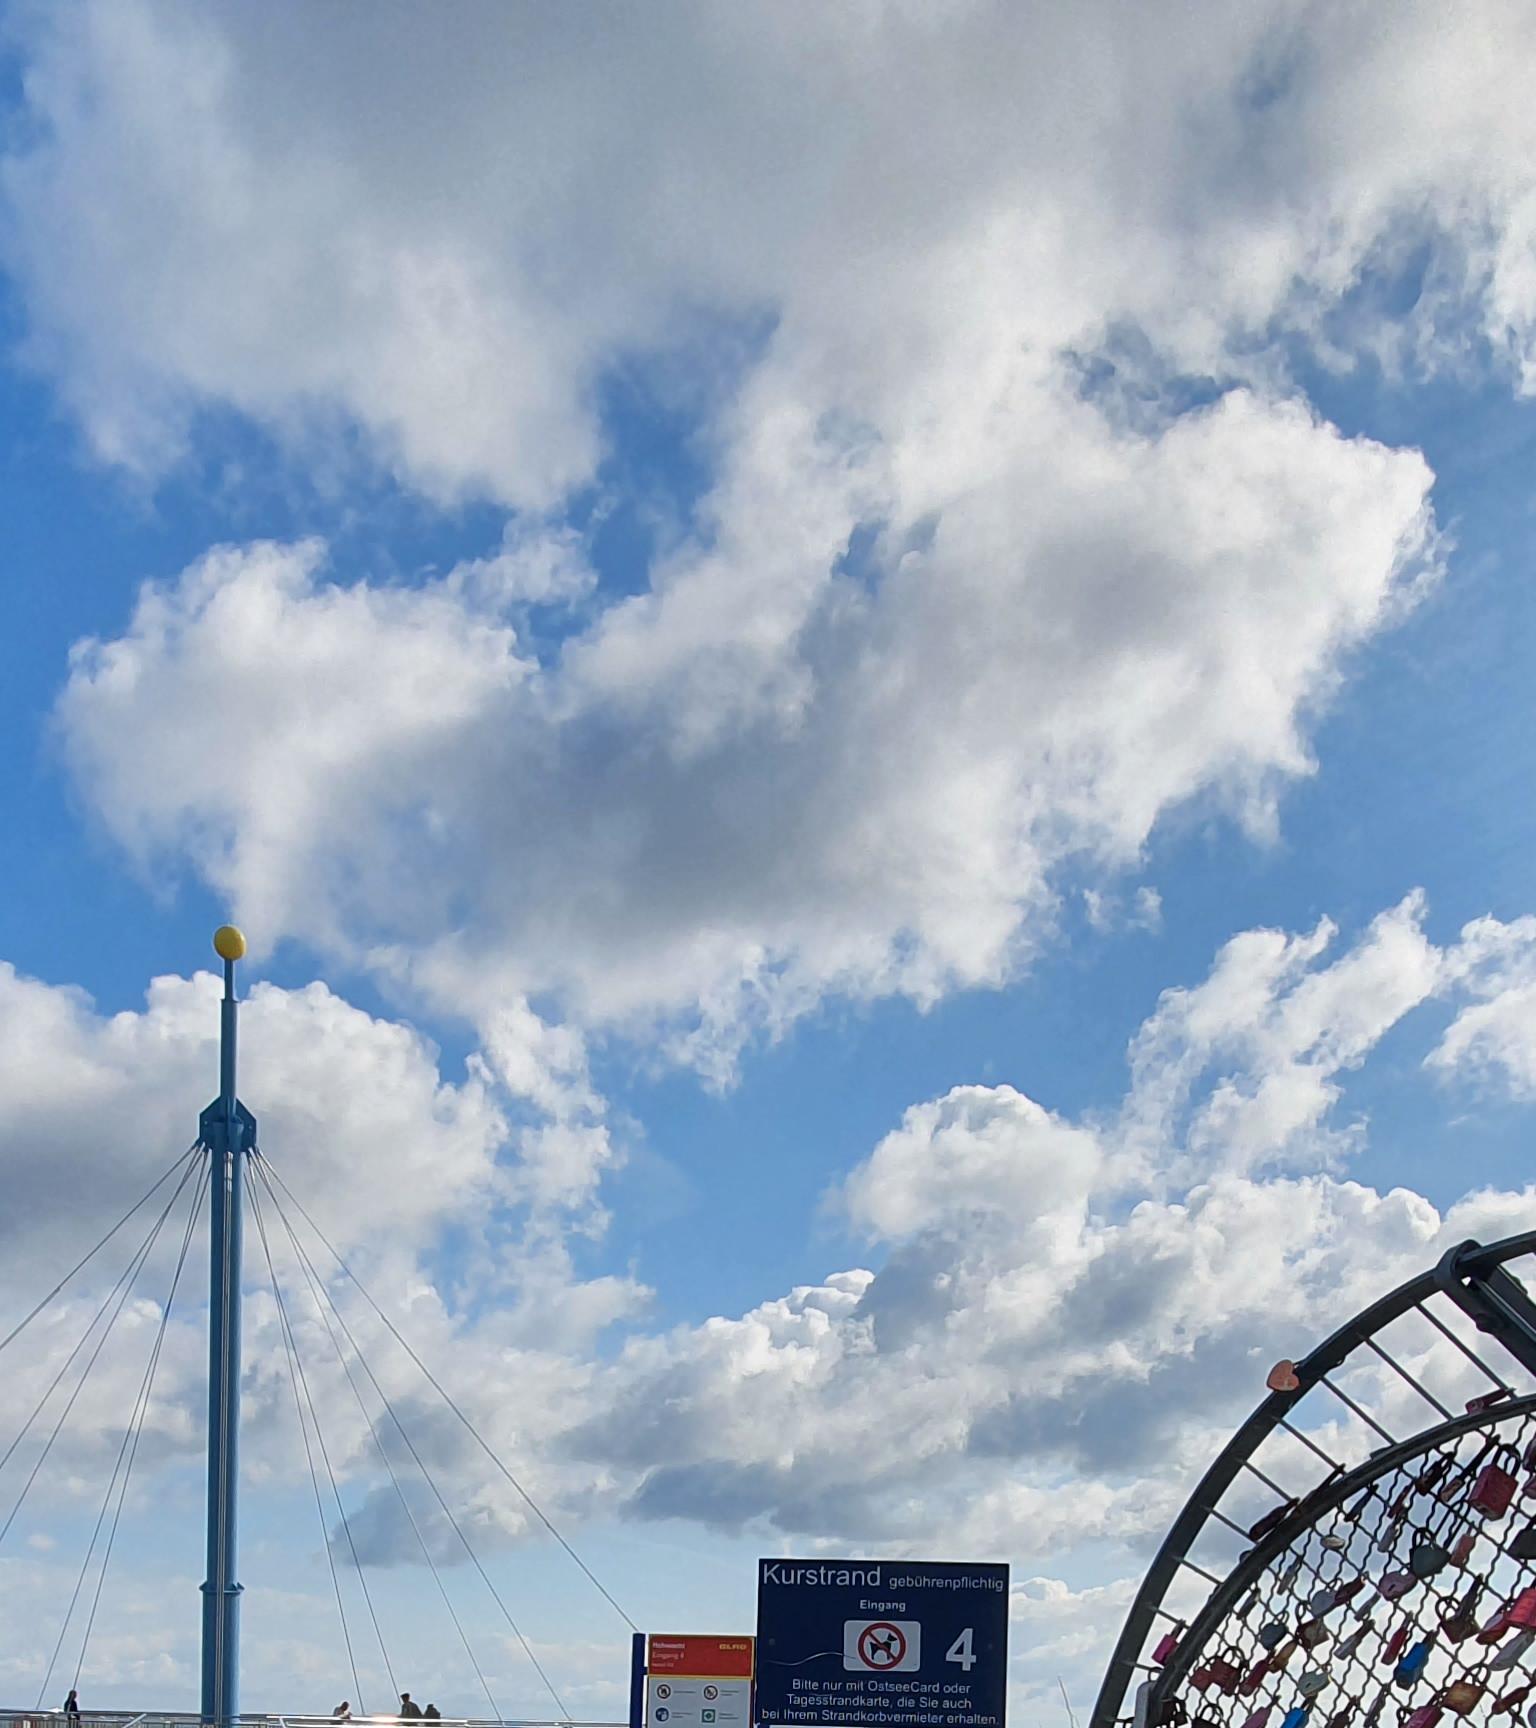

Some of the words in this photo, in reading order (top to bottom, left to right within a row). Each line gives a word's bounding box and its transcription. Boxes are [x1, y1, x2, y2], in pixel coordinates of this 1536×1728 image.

[763, 1563, 881, 1586] Kurstrand
[889, 1576, 1004, 1592] gebührenpflichtig
[860, 1600, 906, 1612] Eingang
[945, 1628, 977, 1671] 4
[792, 1679, 819, 1690] Bitte
[823, 1681, 843, 1691] nur
[846, 1680, 864, 1691] mit
[868, 1680, 940, 1693] OstseeCard
[943, 1683, 971, 1694] oder
[786, 1694, 893, 1709] Tagesstrandkarte,
[897, 1697, 915, 1708] die
[919, 1697, 939, 1709] Sie
[943, 1698, 972, 1709] auch
[762, 1709, 780, 1719] bei
[784, 1709, 818, 1720] Ihrem
[822, 1709, 944, 1723] Strandkorbvermieter
